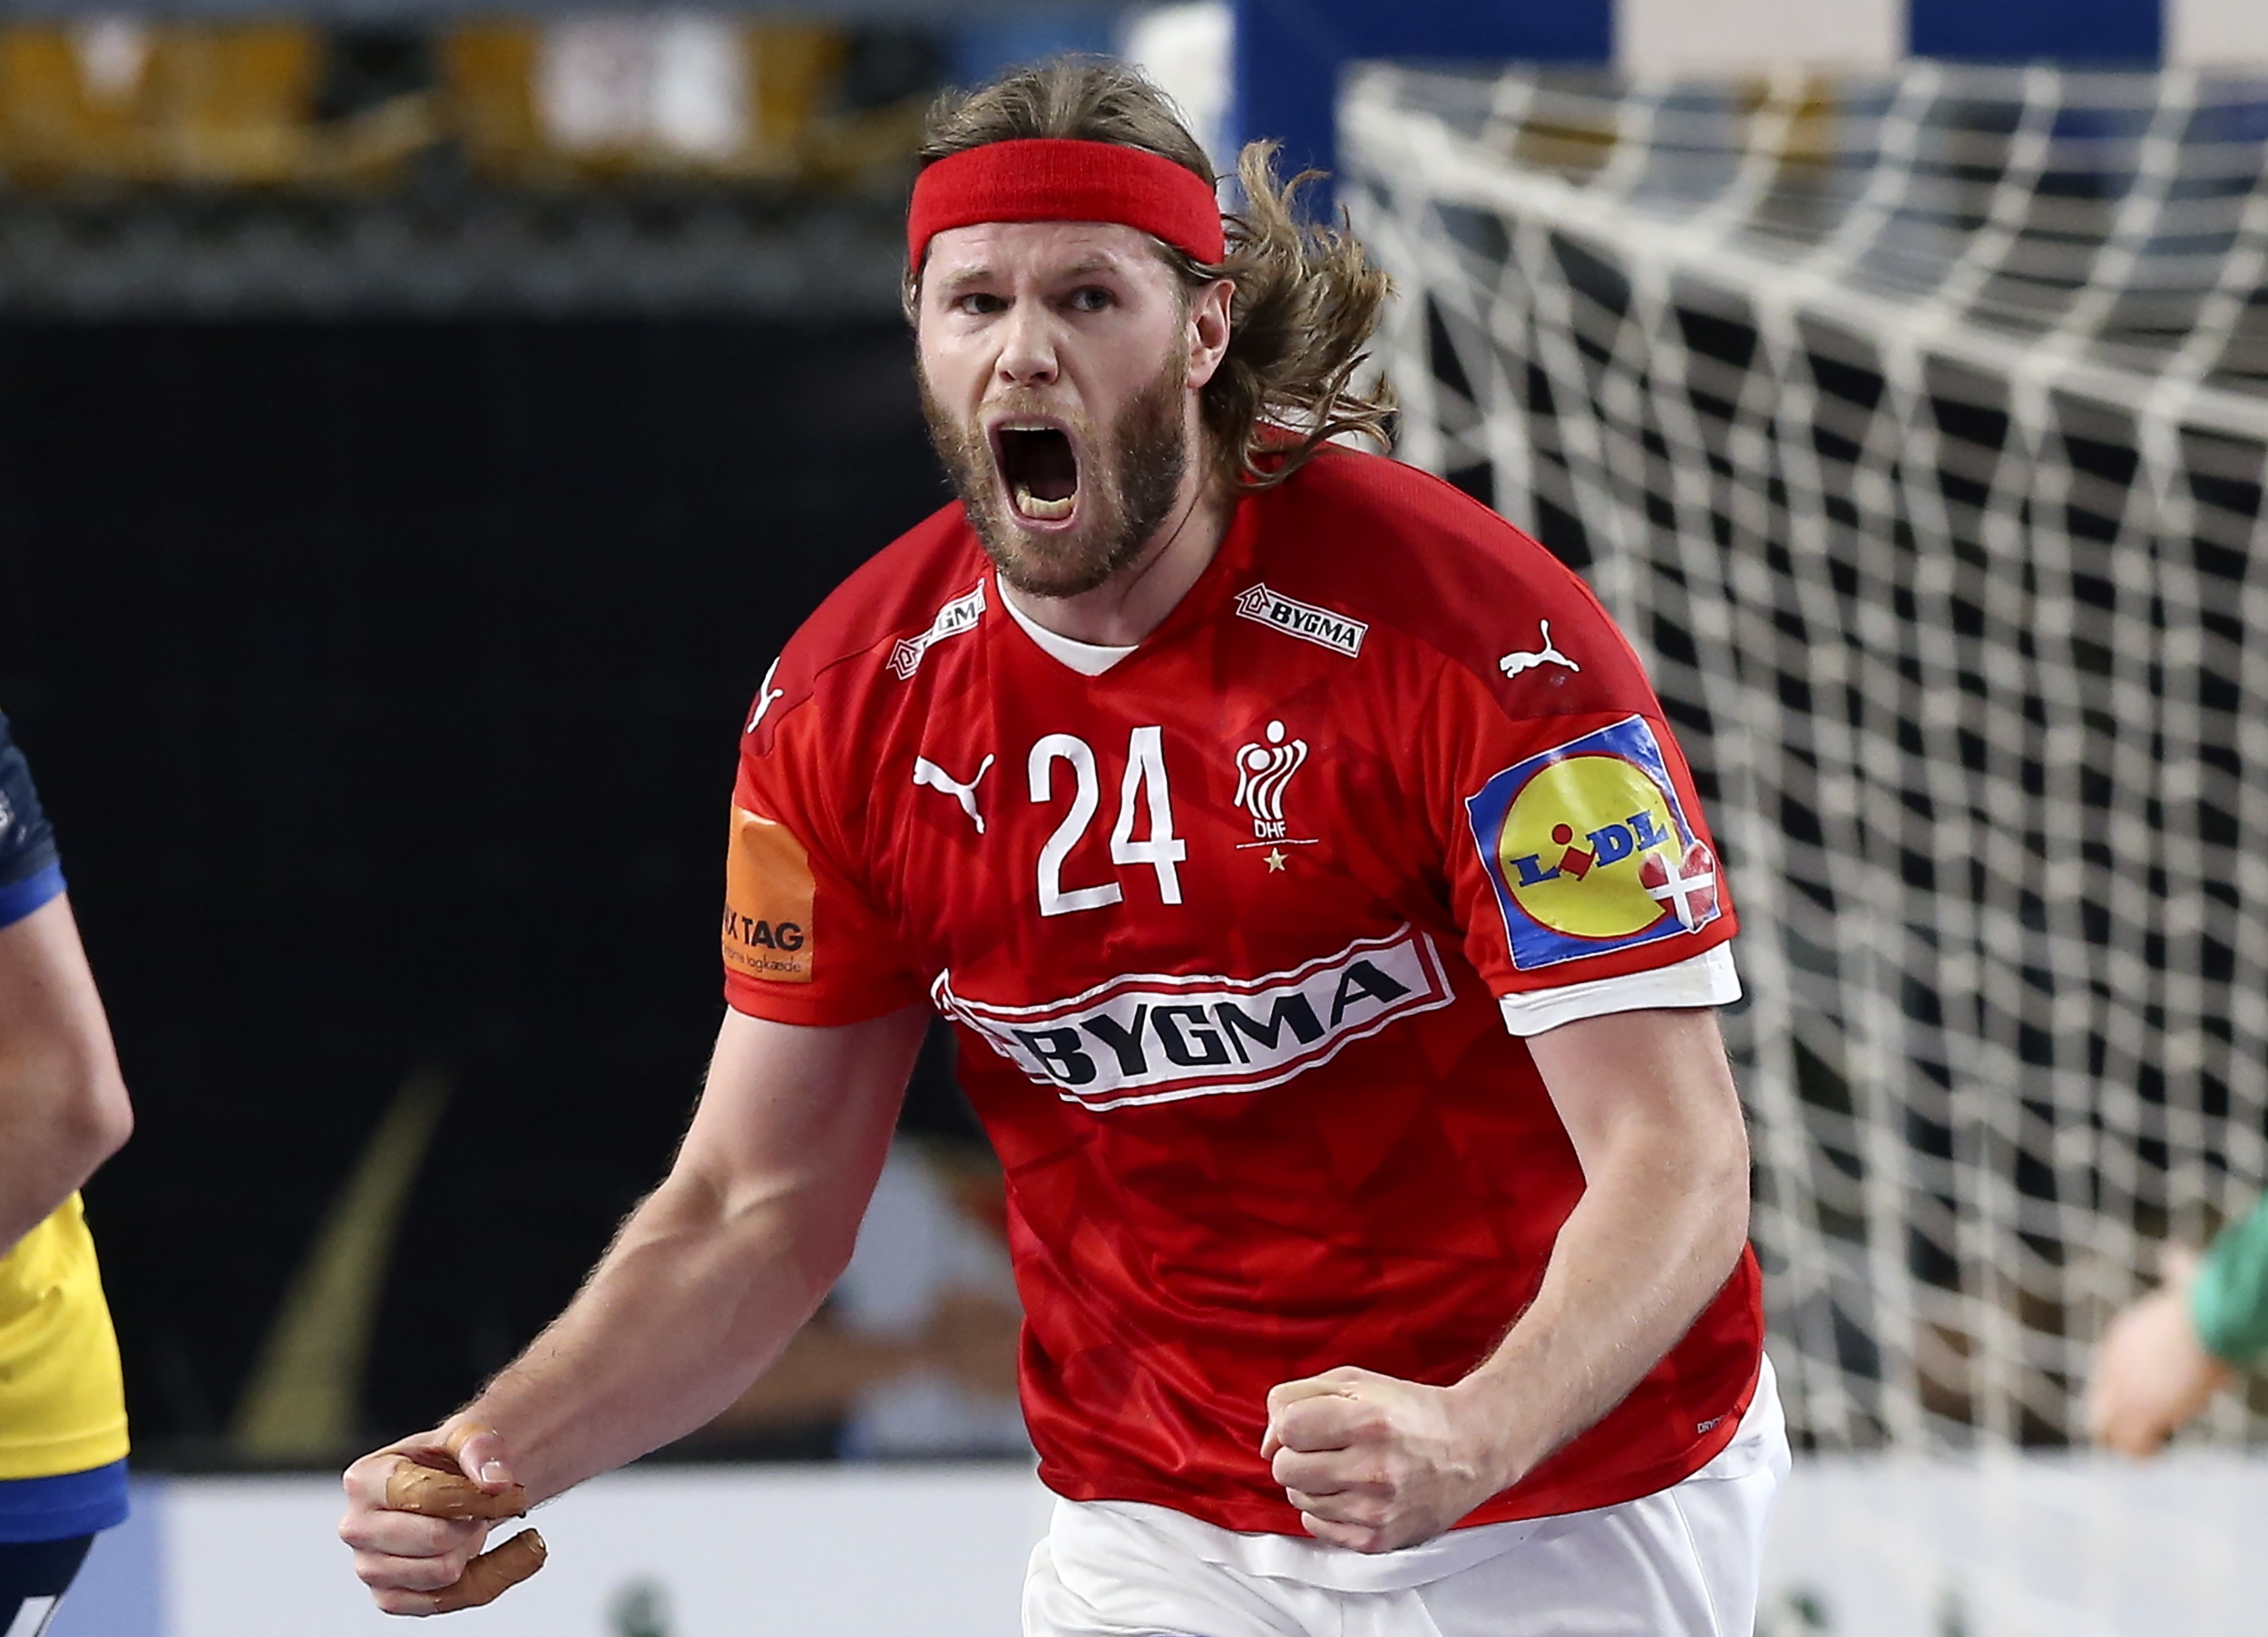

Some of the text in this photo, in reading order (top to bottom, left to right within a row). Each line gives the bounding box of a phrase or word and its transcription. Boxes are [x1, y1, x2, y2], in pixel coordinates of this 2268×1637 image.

[1270, 602, 1356, 648] BYGMA
[1029, 726, 1186, 916] 24
[1254, 819, 1286, 838] DHF
[742, 916, 805, 952] TAG
[1012, 960, 1411, 1085] BYGMA
